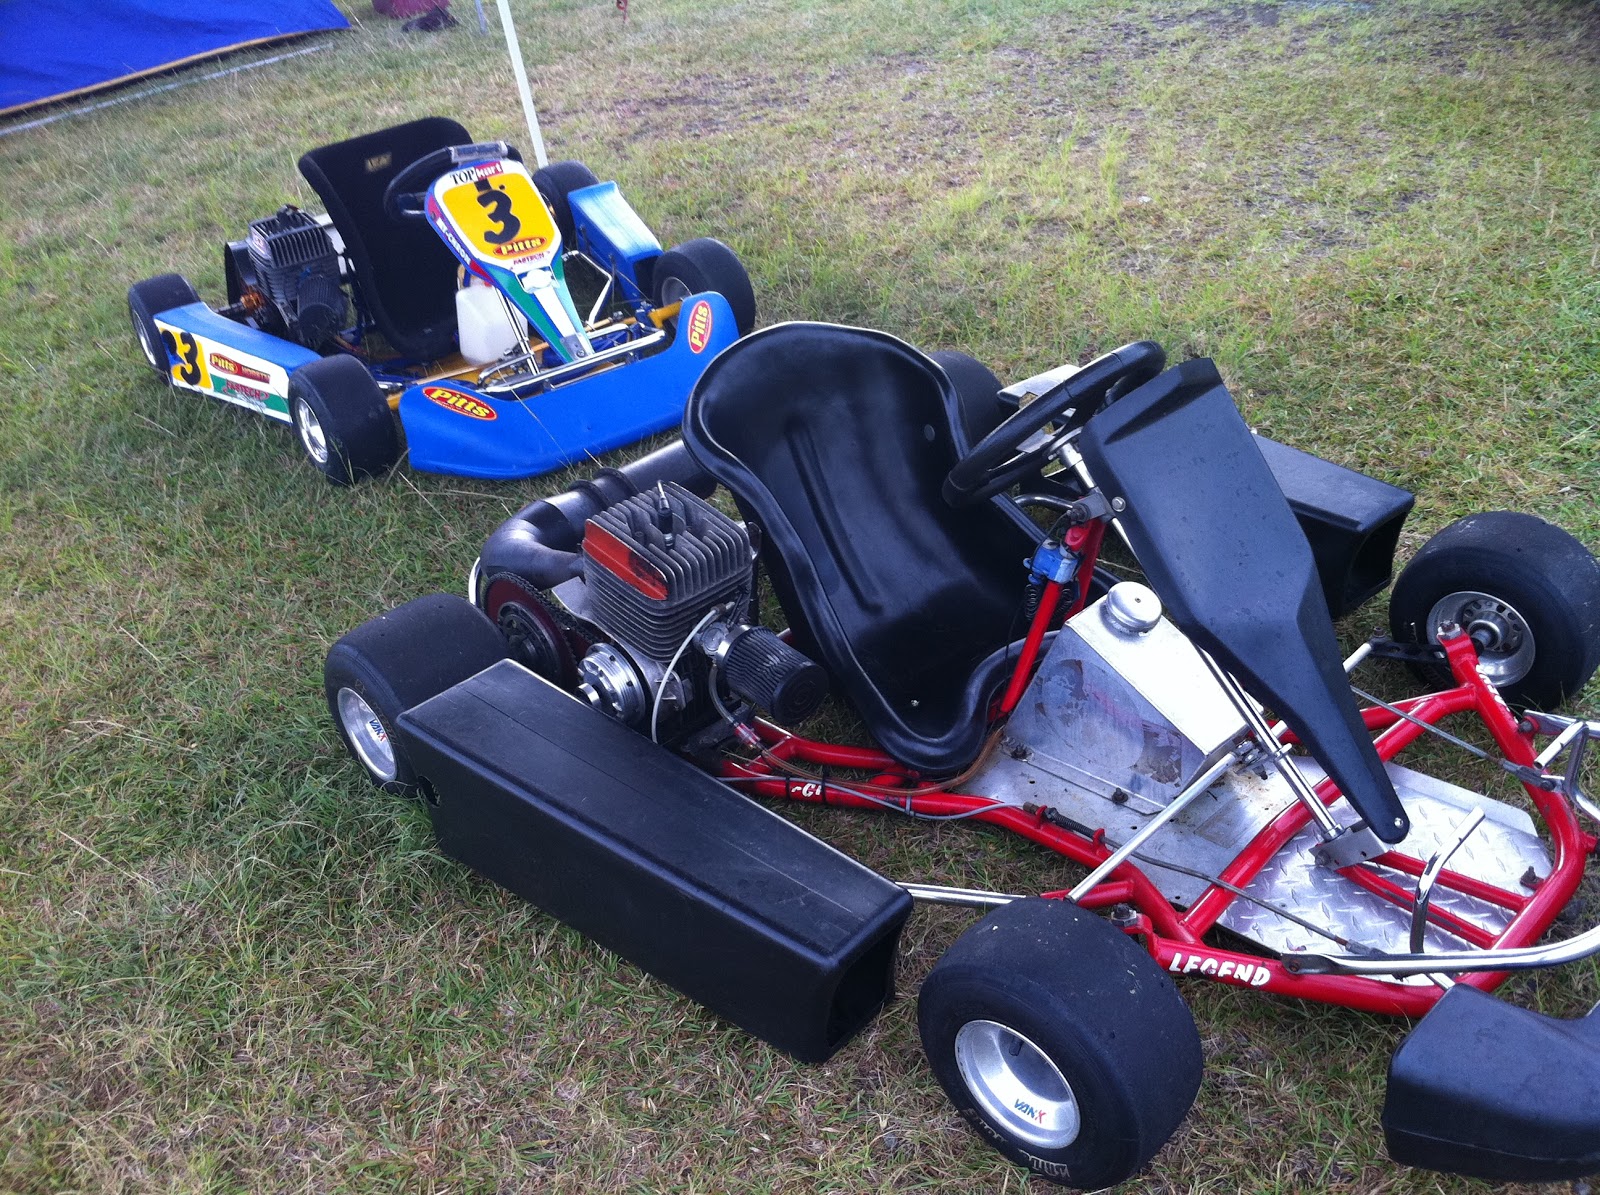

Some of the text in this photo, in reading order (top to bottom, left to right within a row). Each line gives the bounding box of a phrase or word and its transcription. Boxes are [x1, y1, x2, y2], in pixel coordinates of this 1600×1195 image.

[477, 189, 521, 245] 3
[500, 238, 542, 255] Pitts
[691, 305, 708, 347] Pitts
[211, 354, 236, 372] Pitts
[428, 389, 490, 417] Pitts
